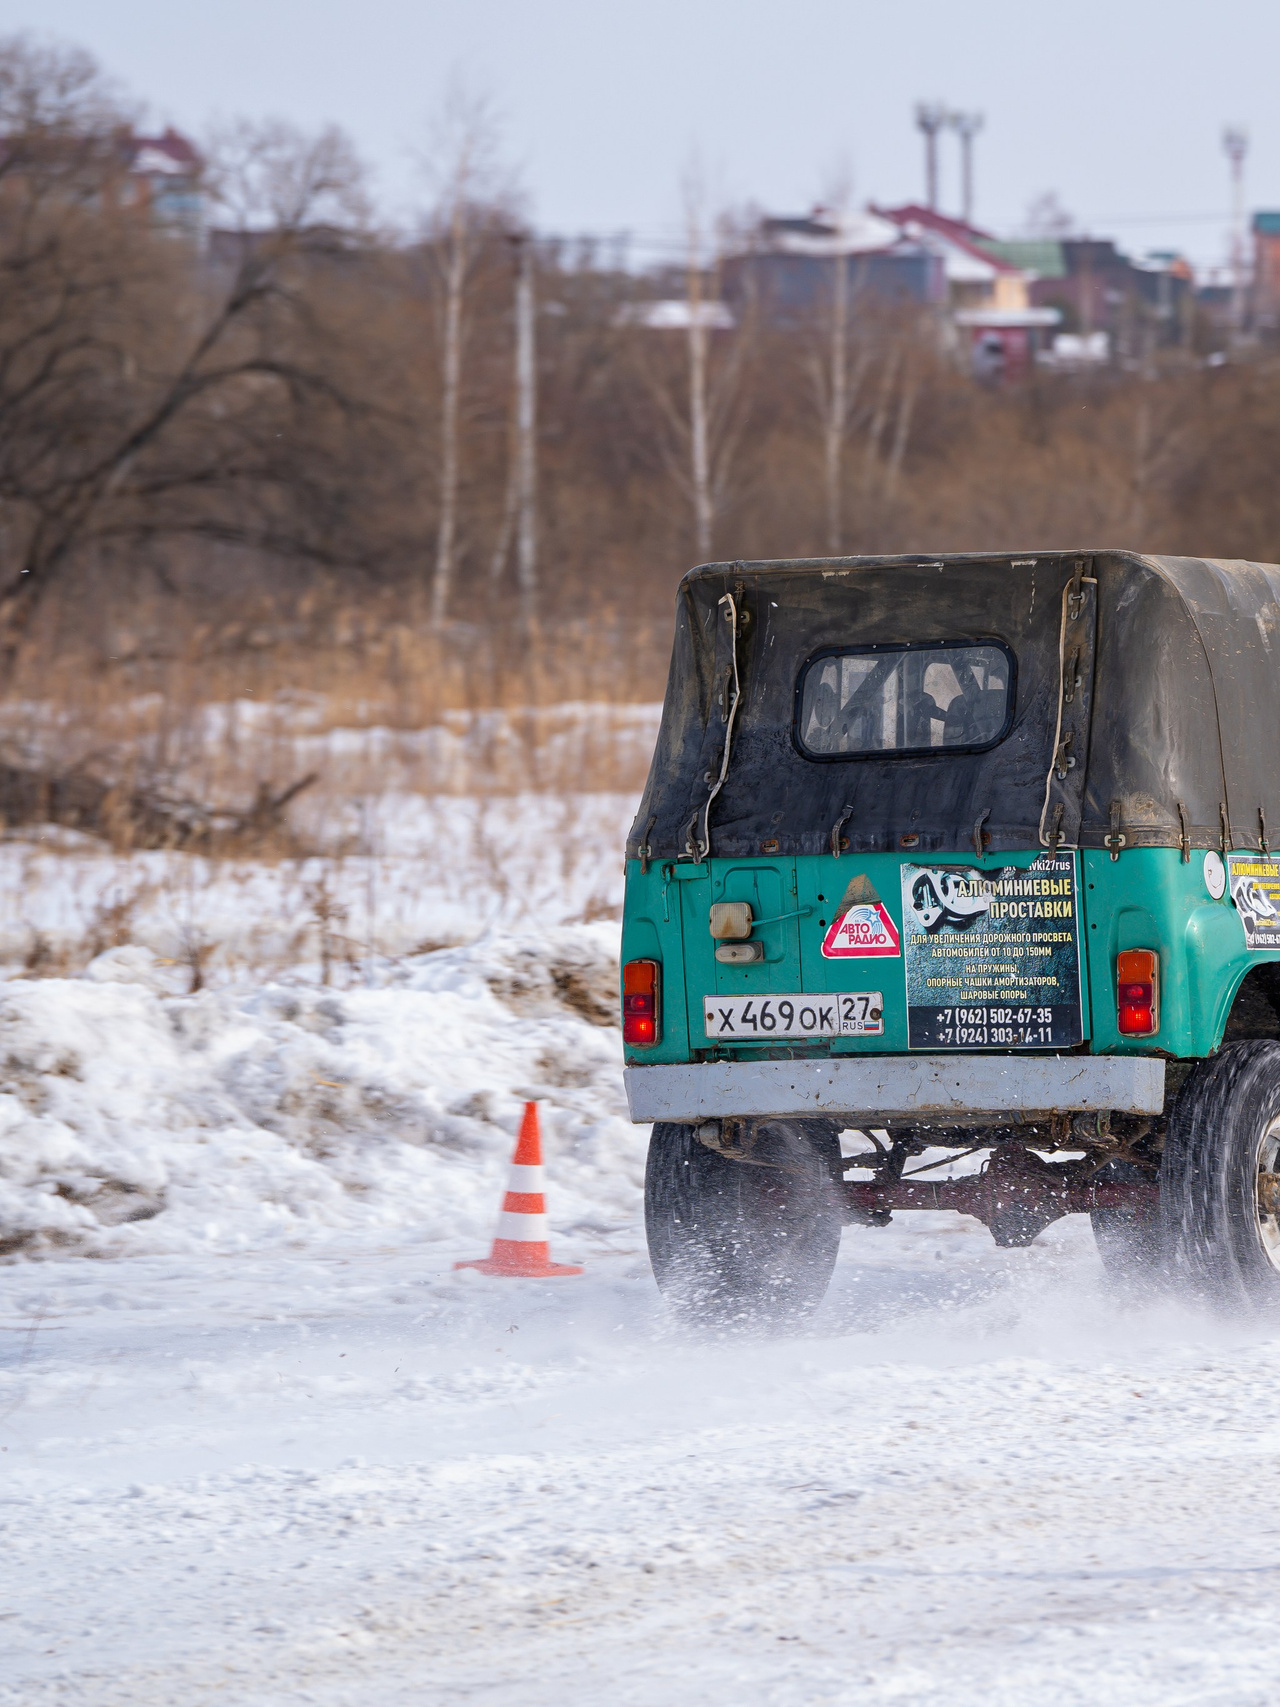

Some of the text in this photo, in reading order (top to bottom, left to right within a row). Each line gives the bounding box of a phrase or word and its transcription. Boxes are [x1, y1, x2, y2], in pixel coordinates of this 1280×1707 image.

[957, 878, 1072, 897] АЛЮМИНИЕВЫЕ
[989, 901, 1073, 919] ПРОСТАВКИ
[839, 922, 870, 935] АВТО
[848, 933, 887, 945] РАДИО
[911, 932, 1073, 945] ДЛЯ УВЕЛИЧЕНИЯ ДОРОЖНОГО ПРОСВЕТА
[931, 946, 1052, 959] АВТОМОБИЛЕЙ ОТ 10 ДО 150ММ
[965, 964, 1020, 974] НА ПРУЖИНЫ,
[926, 976, 1060, 987] ОПОРНЫЕ ЧАШКИ АМОРТИЗАТОРОВ,
[960, 990, 1027, 1000] ШАРОВЫЕ ОПОРЫ
[842, 997, 870, 1021] 27
[937, 1008, 1052, 1025] +7 (962) 502-67-35
[842, 1021, 864, 1030] RUS
[938, 1027, 1052, 1044] +7 (924) 303-14-11
